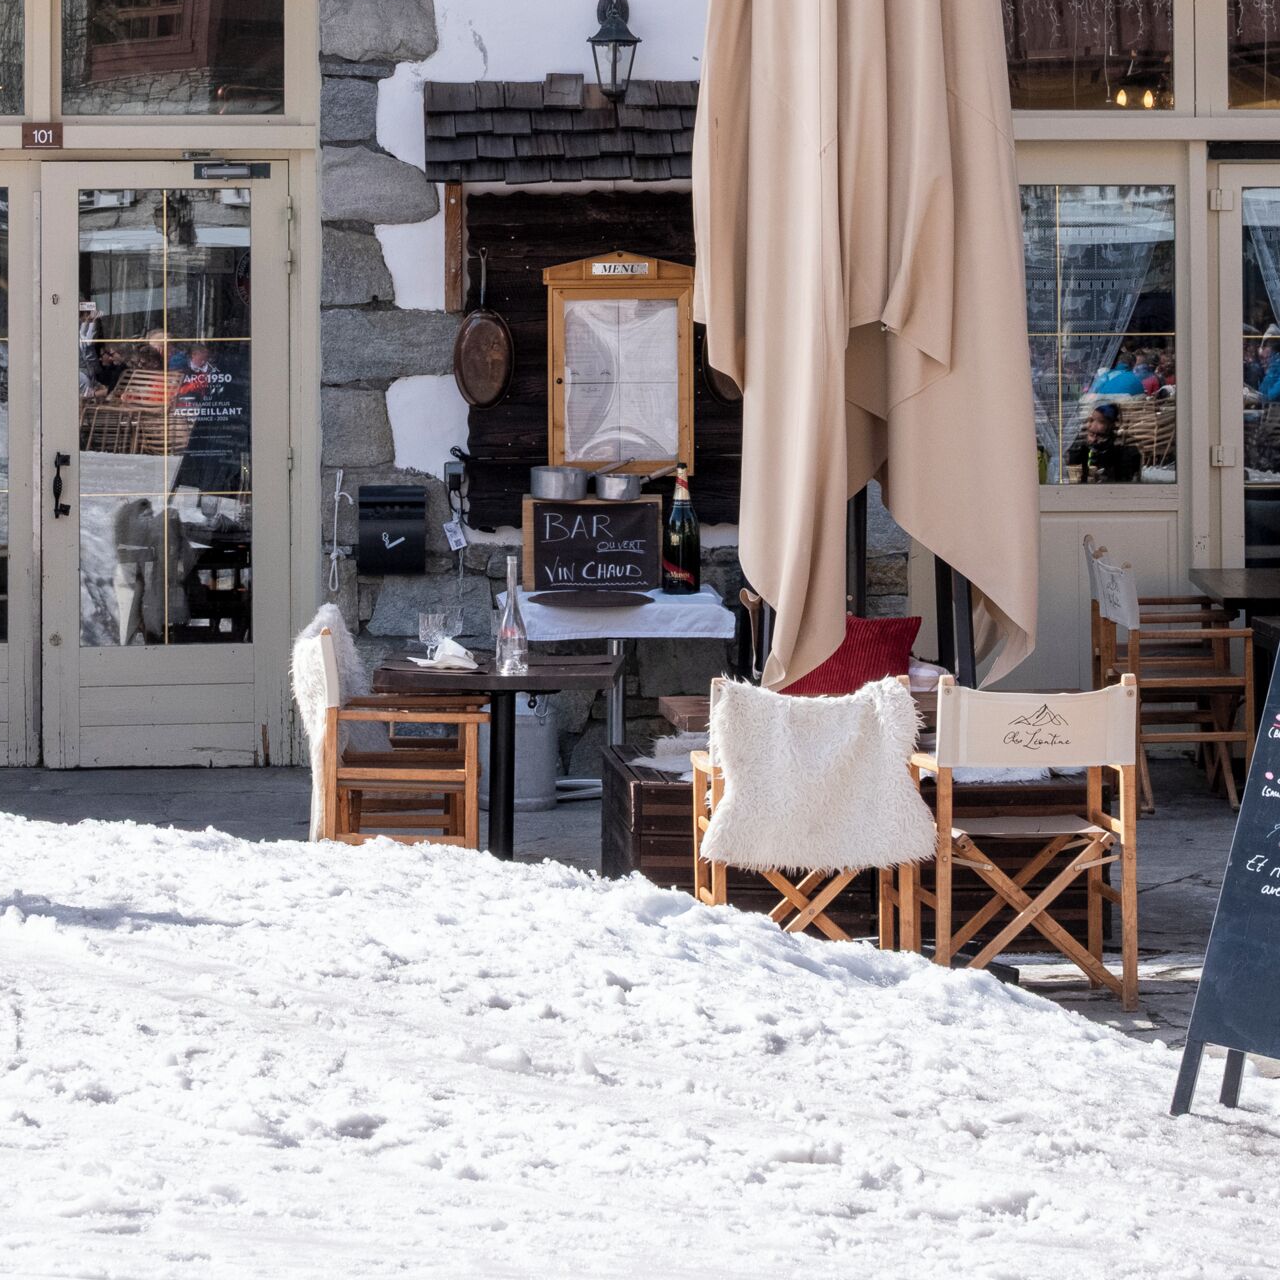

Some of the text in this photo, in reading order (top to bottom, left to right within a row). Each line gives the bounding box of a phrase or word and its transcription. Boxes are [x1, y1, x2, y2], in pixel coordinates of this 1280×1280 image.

[31, 130, 53, 144] 101
[600, 264, 640, 275] MENU
[173, 407, 243, 417] ACCUEILLANT
[540, 513, 614, 543] BAR
[596, 539, 647, 551] OUVERT
[582, 561, 643, 580] CHAUD
[1246, 854, 1268, 872] Et
